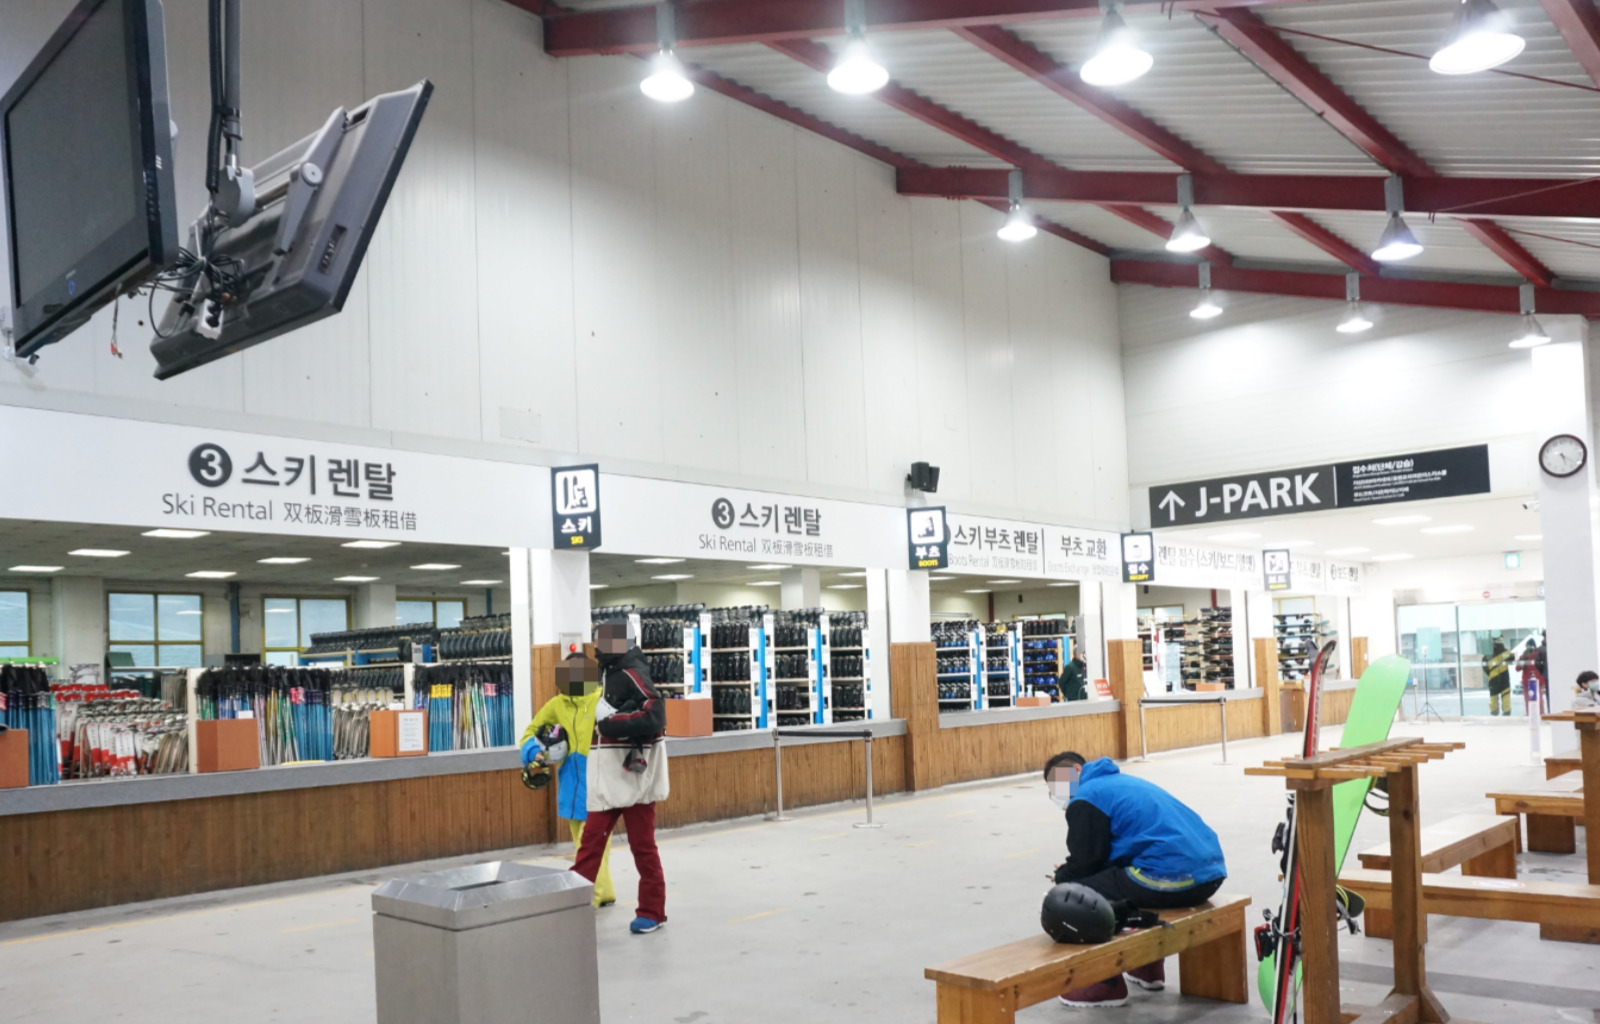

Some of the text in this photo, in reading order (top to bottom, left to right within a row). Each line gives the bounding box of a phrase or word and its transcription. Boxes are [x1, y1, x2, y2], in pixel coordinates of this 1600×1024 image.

[241, 451, 316, 495] 스키
[327, 458, 397, 501] 렌탈
[162, 493, 273, 521] Ski Rental
[1195, 472, 1321, 518] J-PARK
[283, 502, 418, 531] 双板滑雪板租借
[561, 515, 592, 534] 스키
[739, 502, 779, 534] 스키
[784, 506, 821, 537] 렌탈
[698, 533, 757, 553] Ski Rental
[915, 545, 941, 560] 부츠
[954, 524, 1039, 555] 스키 부츠 렌탈
[1061, 535, 1107, 560] 부츠 교환
